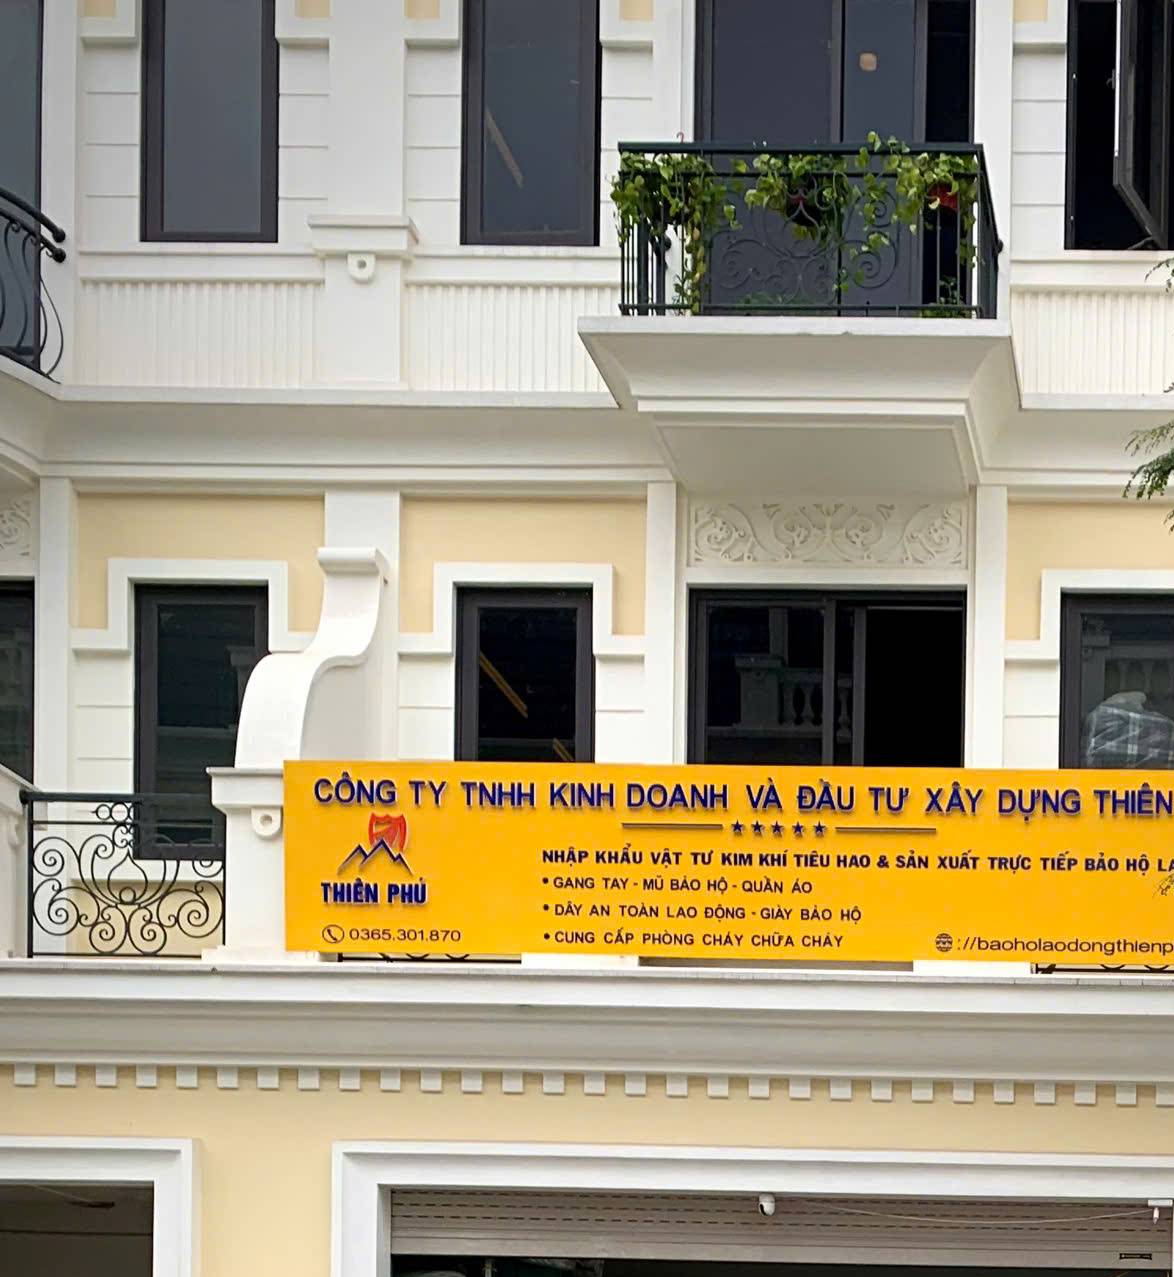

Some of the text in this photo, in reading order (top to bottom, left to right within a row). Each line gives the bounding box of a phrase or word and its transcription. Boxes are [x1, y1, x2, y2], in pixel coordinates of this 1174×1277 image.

[314, 772, 397, 805] CÔNG
[409, 780, 447, 807] TY
[461, 781, 536, 808] TNHH
[550, 782, 615, 809] KINH
[627, 783, 728, 810] DOANH
[746, 777, 783, 811] VÀ
[797, 778, 855, 812] ĐẦU
[869, 785, 910, 812] TƯ
[925, 781, 984, 814] XÂY
[999, 787, 1082, 822] DỰNG
[1093, 782, 1173, 815] THIÊN
[542, 848, 589, 865] NHẬP
[596, 843, 643, 865] KHẨU
[651, 848, 682, 867] VẬT
[691, 851, 713, 866] TƯ
[721, 853, 753, 867] KIM
[759, 849, 788, 867] KHÍ
[793, 848, 830, 868] TIÊU
[836, 854, 871, 868] HAO
[877, 854, 890, 869] &
[896, 849, 929, 869] SẢN
[937, 849, 979, 870] XUẤT
[987, 852, 1032, 875] TRỰC
[1040, 850, 1079, 872] TIẾP
[1085, 852, 1120, 872] BẢO
[1126, 854, 1150, 876] HỘ
[321, 877, 427, 905] THIÊN PHÚ
[553, 877, 595, 890] GANG
[603, 878, 629, 890] TAY
[643, 876, 664, 891] MŨ
[670, 876, 701, 892] BẢO
[707, 877, 729, 895] HỘ
[742, 875, 784, 894] QUẦN
[791, 876, 813, 894] ÁO
[555, 903, 583, 917] DÂY
[589, 905, 611, 917] AN
[619, 902, 659, 918] TOÀN
[667, 906, 698, 919] LAO
[704, 904, 746, 922] ĐỘNG
[760, 904, 793, 920] GIÀY
[800, 904, 833, 921] BẢO
[840, 905, 862, 925] HỘ
[349, 929, 462, 943] 0365.301.870
[554, 927, 844, 948] CUNG CẤP PHÒNG CHÁY CHỮA CHÁY
